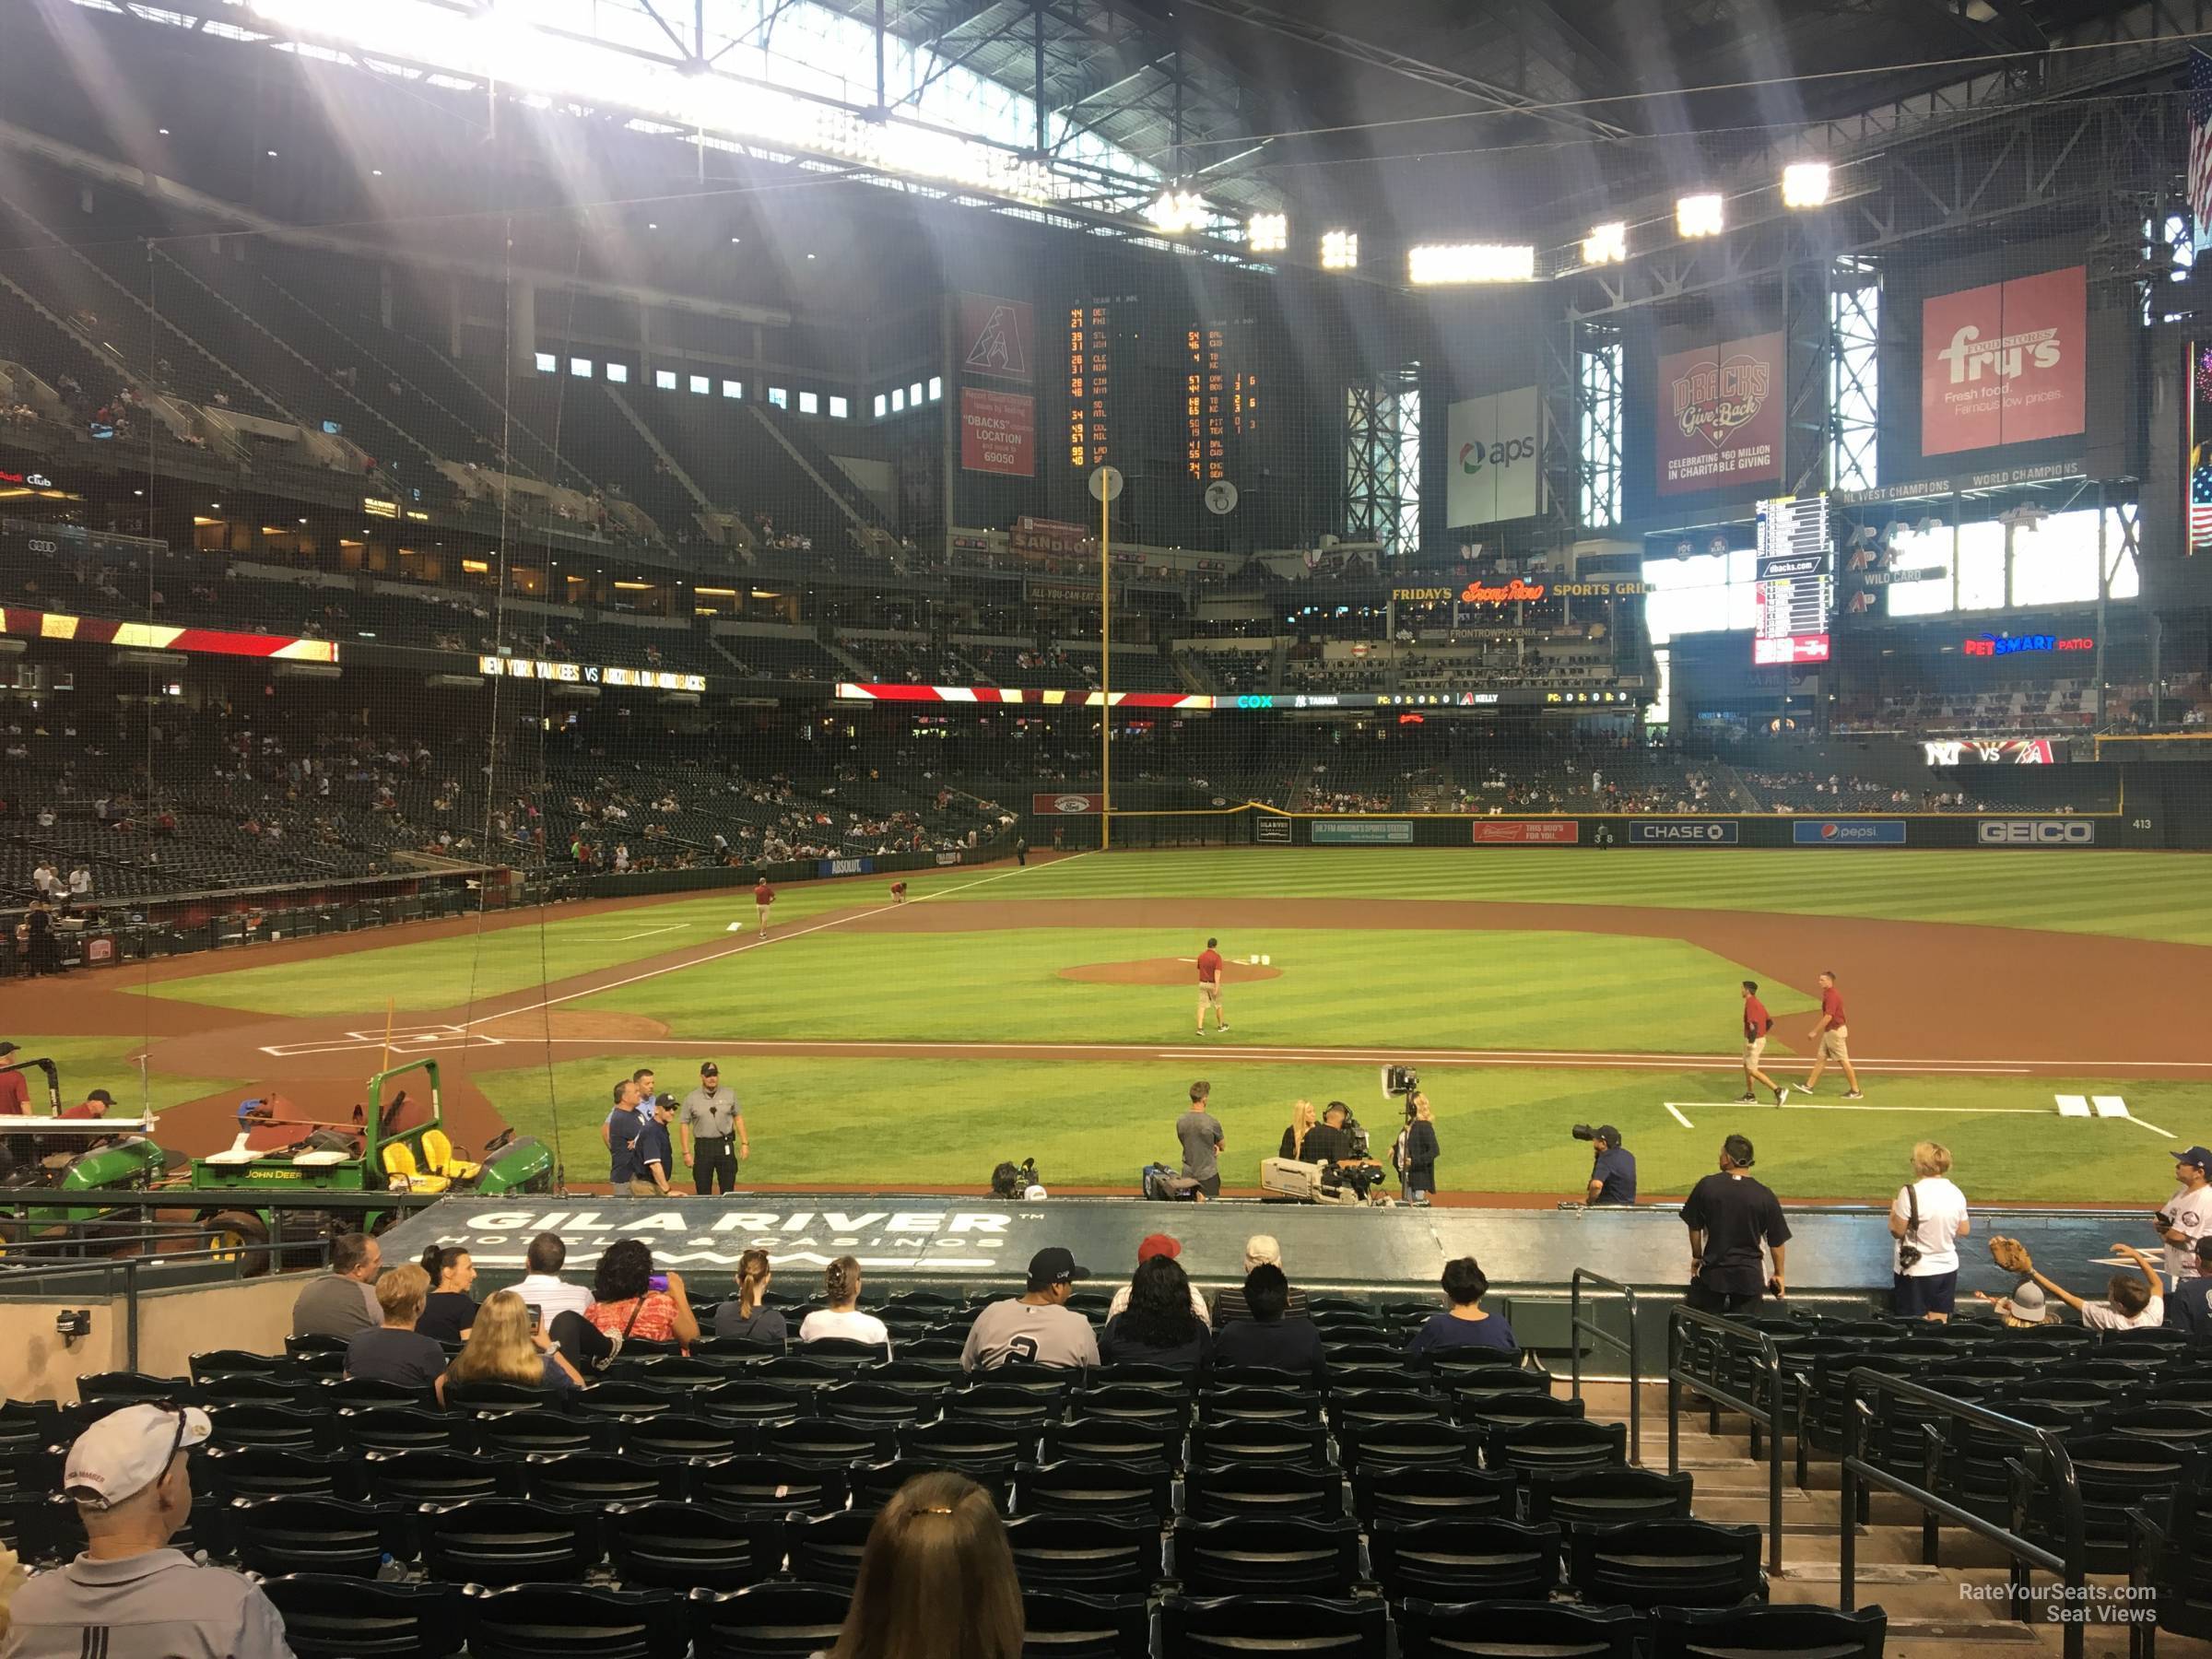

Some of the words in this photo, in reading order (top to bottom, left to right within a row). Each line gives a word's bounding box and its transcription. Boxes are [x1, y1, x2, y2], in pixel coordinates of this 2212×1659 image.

[1071, 309, 1082, 318] 44
[1071, 319, 1082, 328] 27
[1071, 332, 1082, 341] 39
[1188, 332, 1200, 341] 54
[1967, 340, 2001, 354] FOOD
[2002, 330, 2053, 347] STORES
[1071, 341, 1082, 351] 31
[1194, 353, 1200, 362] 4
[1937, 324, 2061, 384] fry's
[1071, 365, 1082, 374] 31
[1188, 376, 1200, 384] 57
[1250, 376, 1255, 385] 6
[1188, 384, 1200, 393] 44
[1235, 382, 1240, 390] 3
[1945, 388, 1978, 403] Fresh
[1981, 382, 2013, 397] food.
[1235, 394, 1240, 403] 2
[1249, 398, 1255, 407] 6
[1955, 400, 2001, 415] Famous
[2002, 395, 2023, 408] low
[2025, 390, 2064, 407] prices.
[1188, 406, 1200, 415] 65
[1682, 406, 1715, 434] Give
[1715, 395, 1758, 427] Back
[1235, 417, 1240, 425] 0
[976, 429, 1022, 444] LOCATION
[1188, 450, 1200, 459] 55
[1489, 436, 1534, 468] aps
[1668, 453, 1719, 470] CELEBRATING
[1721, 450, 1736, 459] $60
[1738, 445, 1771, 458] MILLION
[984, 452, 1015, 465] 69050
[1071, 456, 1082, 465] 40
[1668, 470, 1678, 480] IN
[1680, 461, 1735, 478] CHARITABLE
[1738, 454, 1771, 469] GIVING
[27, 475, 52, 487] Club
[1194, 471, 1200, 480] 7
[1843, 491, 1856, 504] NL
[1889, 480, 1950, 498] CHAMPIONS
[1973, 474, 2009, 487] WORLD
[2012, 462, 2078, 482] CHAMPIONS
[1015, 534, 1094, 554] SANDLOT
[1770, 561, 1813, 574] dbacks.com
[1865, 573, 1890, 585] WILD
[1894, 570, 1922, 583] CARD
[1393, 587, 1452, 600] FRIDAY'S
[1553, 583, 1610, 596] SPORTS
[2059, 638, 2094, 650] PATIO
[479, 656, 504, 675] NEW
[506, 659, 535, 678] YORK
[536, 661, 580, 681] YANKEES
[585, 667, 598, 682] VS
[602, 667, 641, 687] ARIZONA
[641, 671, 706, 691] DIAMONDBACKS
[1237, 695, 1273, 708] COX
[1309, 696, 1338, 705] TANAKA
[1377, 696, 1391, 705] PC:
[1406, 696, 1414, 705] S:
[1430, 695, 1437, 704] B:
[1476, 694, 1498, 703] KELLY
[1547, 694, 1561, 702] PC:
[1980, 747, 2000, 762] VS
[2133, 819, 2152, 830] 413
[1644, 826, 1704, 838] CHASE
[1841, 826, 1877, 838] pepsi
[1982, 822, 2092, 842] GEICO
[1594, 835, 1613, 843] 38
[245, 1170, 273, 1179] JOHN
[466, 1212, 688, 1231] GILA
[711, 1212, 1012, 1232] RIVER
[750, 1238, 1005, 1248] CASINOS
